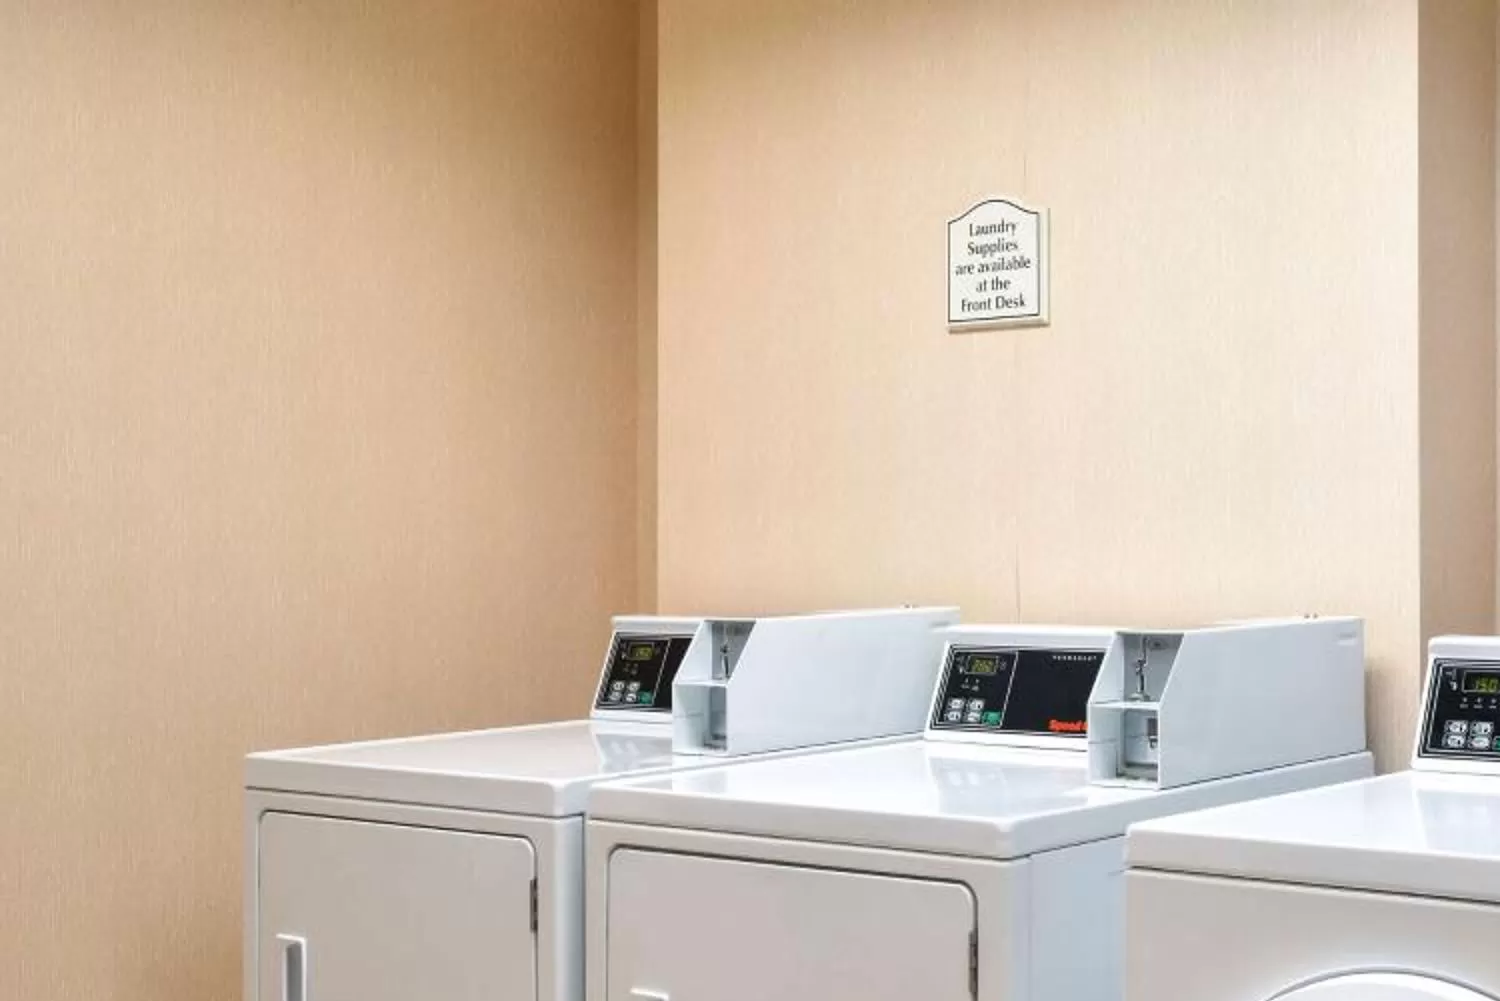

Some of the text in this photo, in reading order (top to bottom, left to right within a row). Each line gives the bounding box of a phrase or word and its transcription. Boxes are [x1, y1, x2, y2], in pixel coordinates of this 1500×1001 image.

[969, 218, 1017, 237] Laundry
[967, 238, 1018, 258] Supplies
[955, 255, 1031, 276] are available
[975, 276, 1011, 292] at the
[961, 292, 1025, 312] Front Desk
